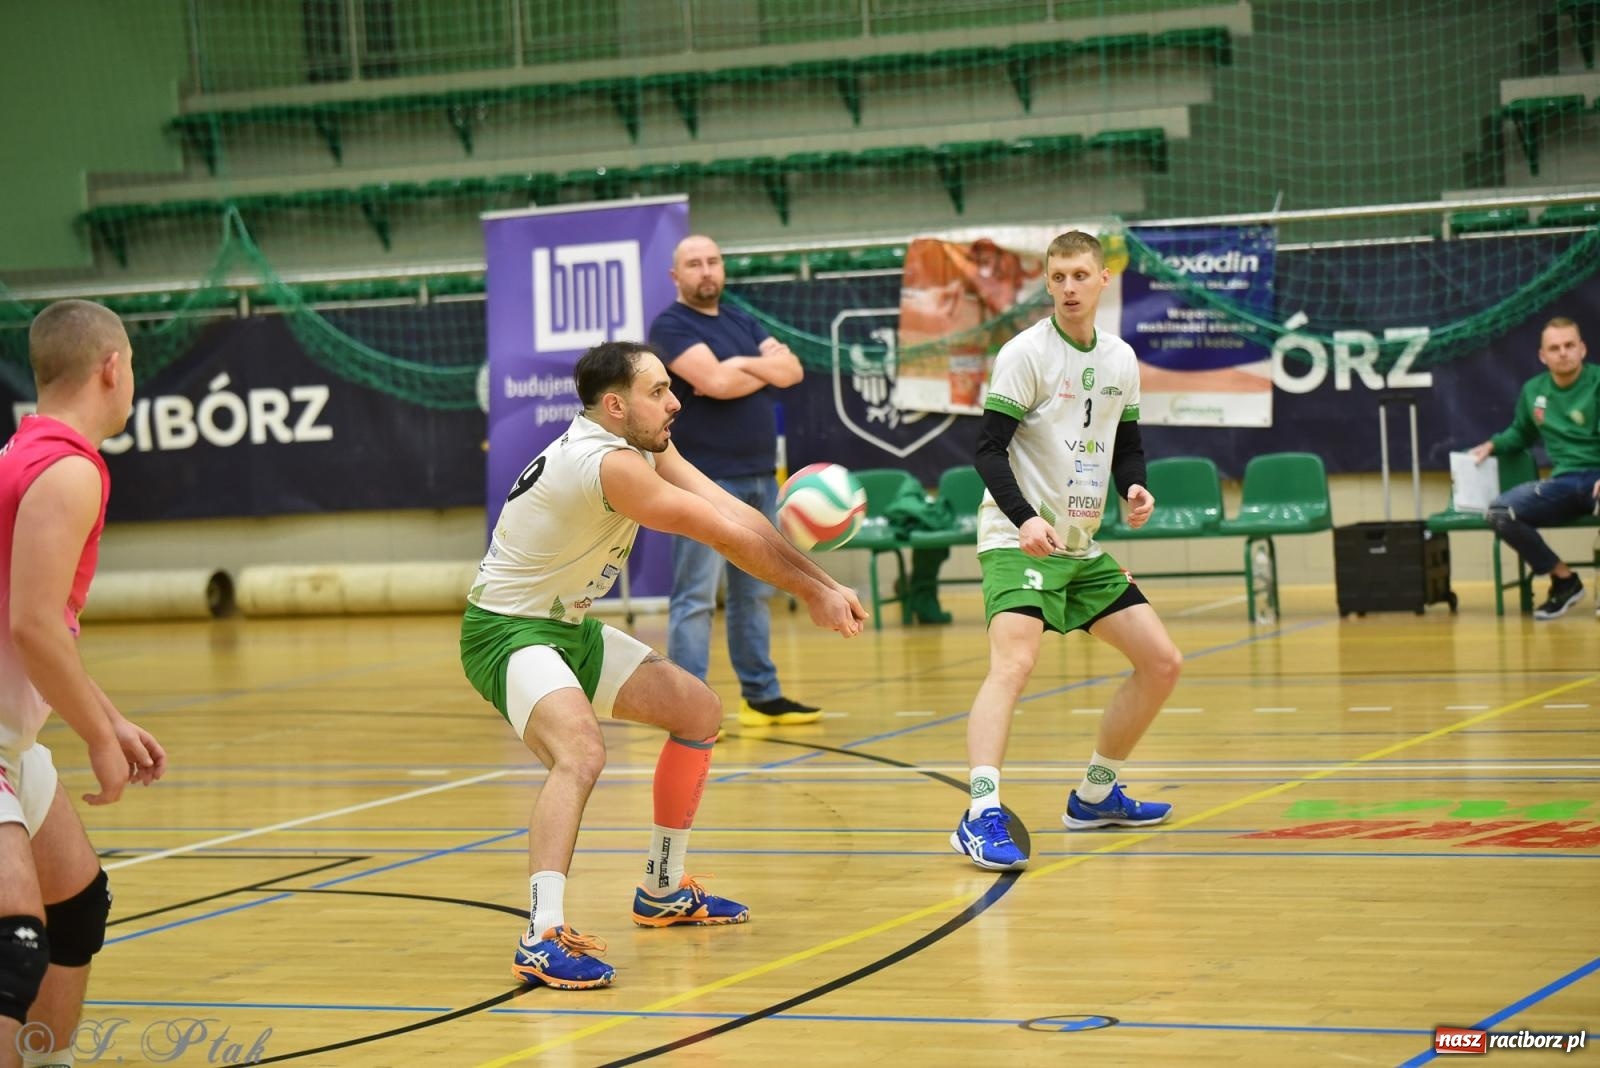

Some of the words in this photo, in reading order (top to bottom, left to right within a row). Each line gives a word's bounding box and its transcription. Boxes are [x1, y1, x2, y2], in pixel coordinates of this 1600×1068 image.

[545, 244, 632, 345] bmp
[13, 372, 334, 455] IBÓRZ
[1082, 398, 1093, 429] 3
[1022, 568, 1044, 590] 3
